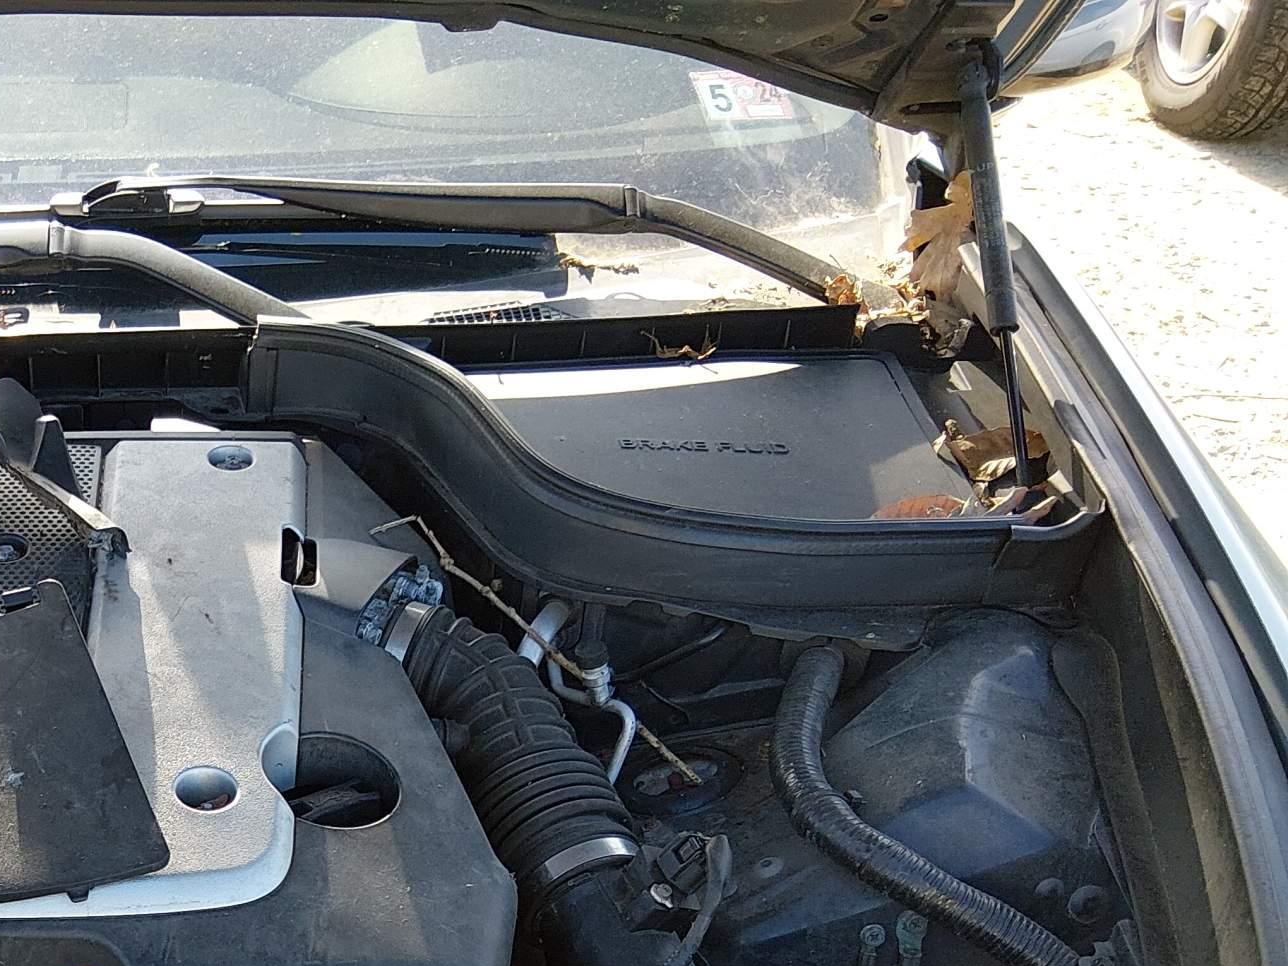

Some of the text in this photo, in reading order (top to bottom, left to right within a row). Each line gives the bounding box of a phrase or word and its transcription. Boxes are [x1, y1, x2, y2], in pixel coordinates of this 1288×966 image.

[708, 84, 733, 112] 5
[617, 438, 791, 455] BRAKE FLUID
